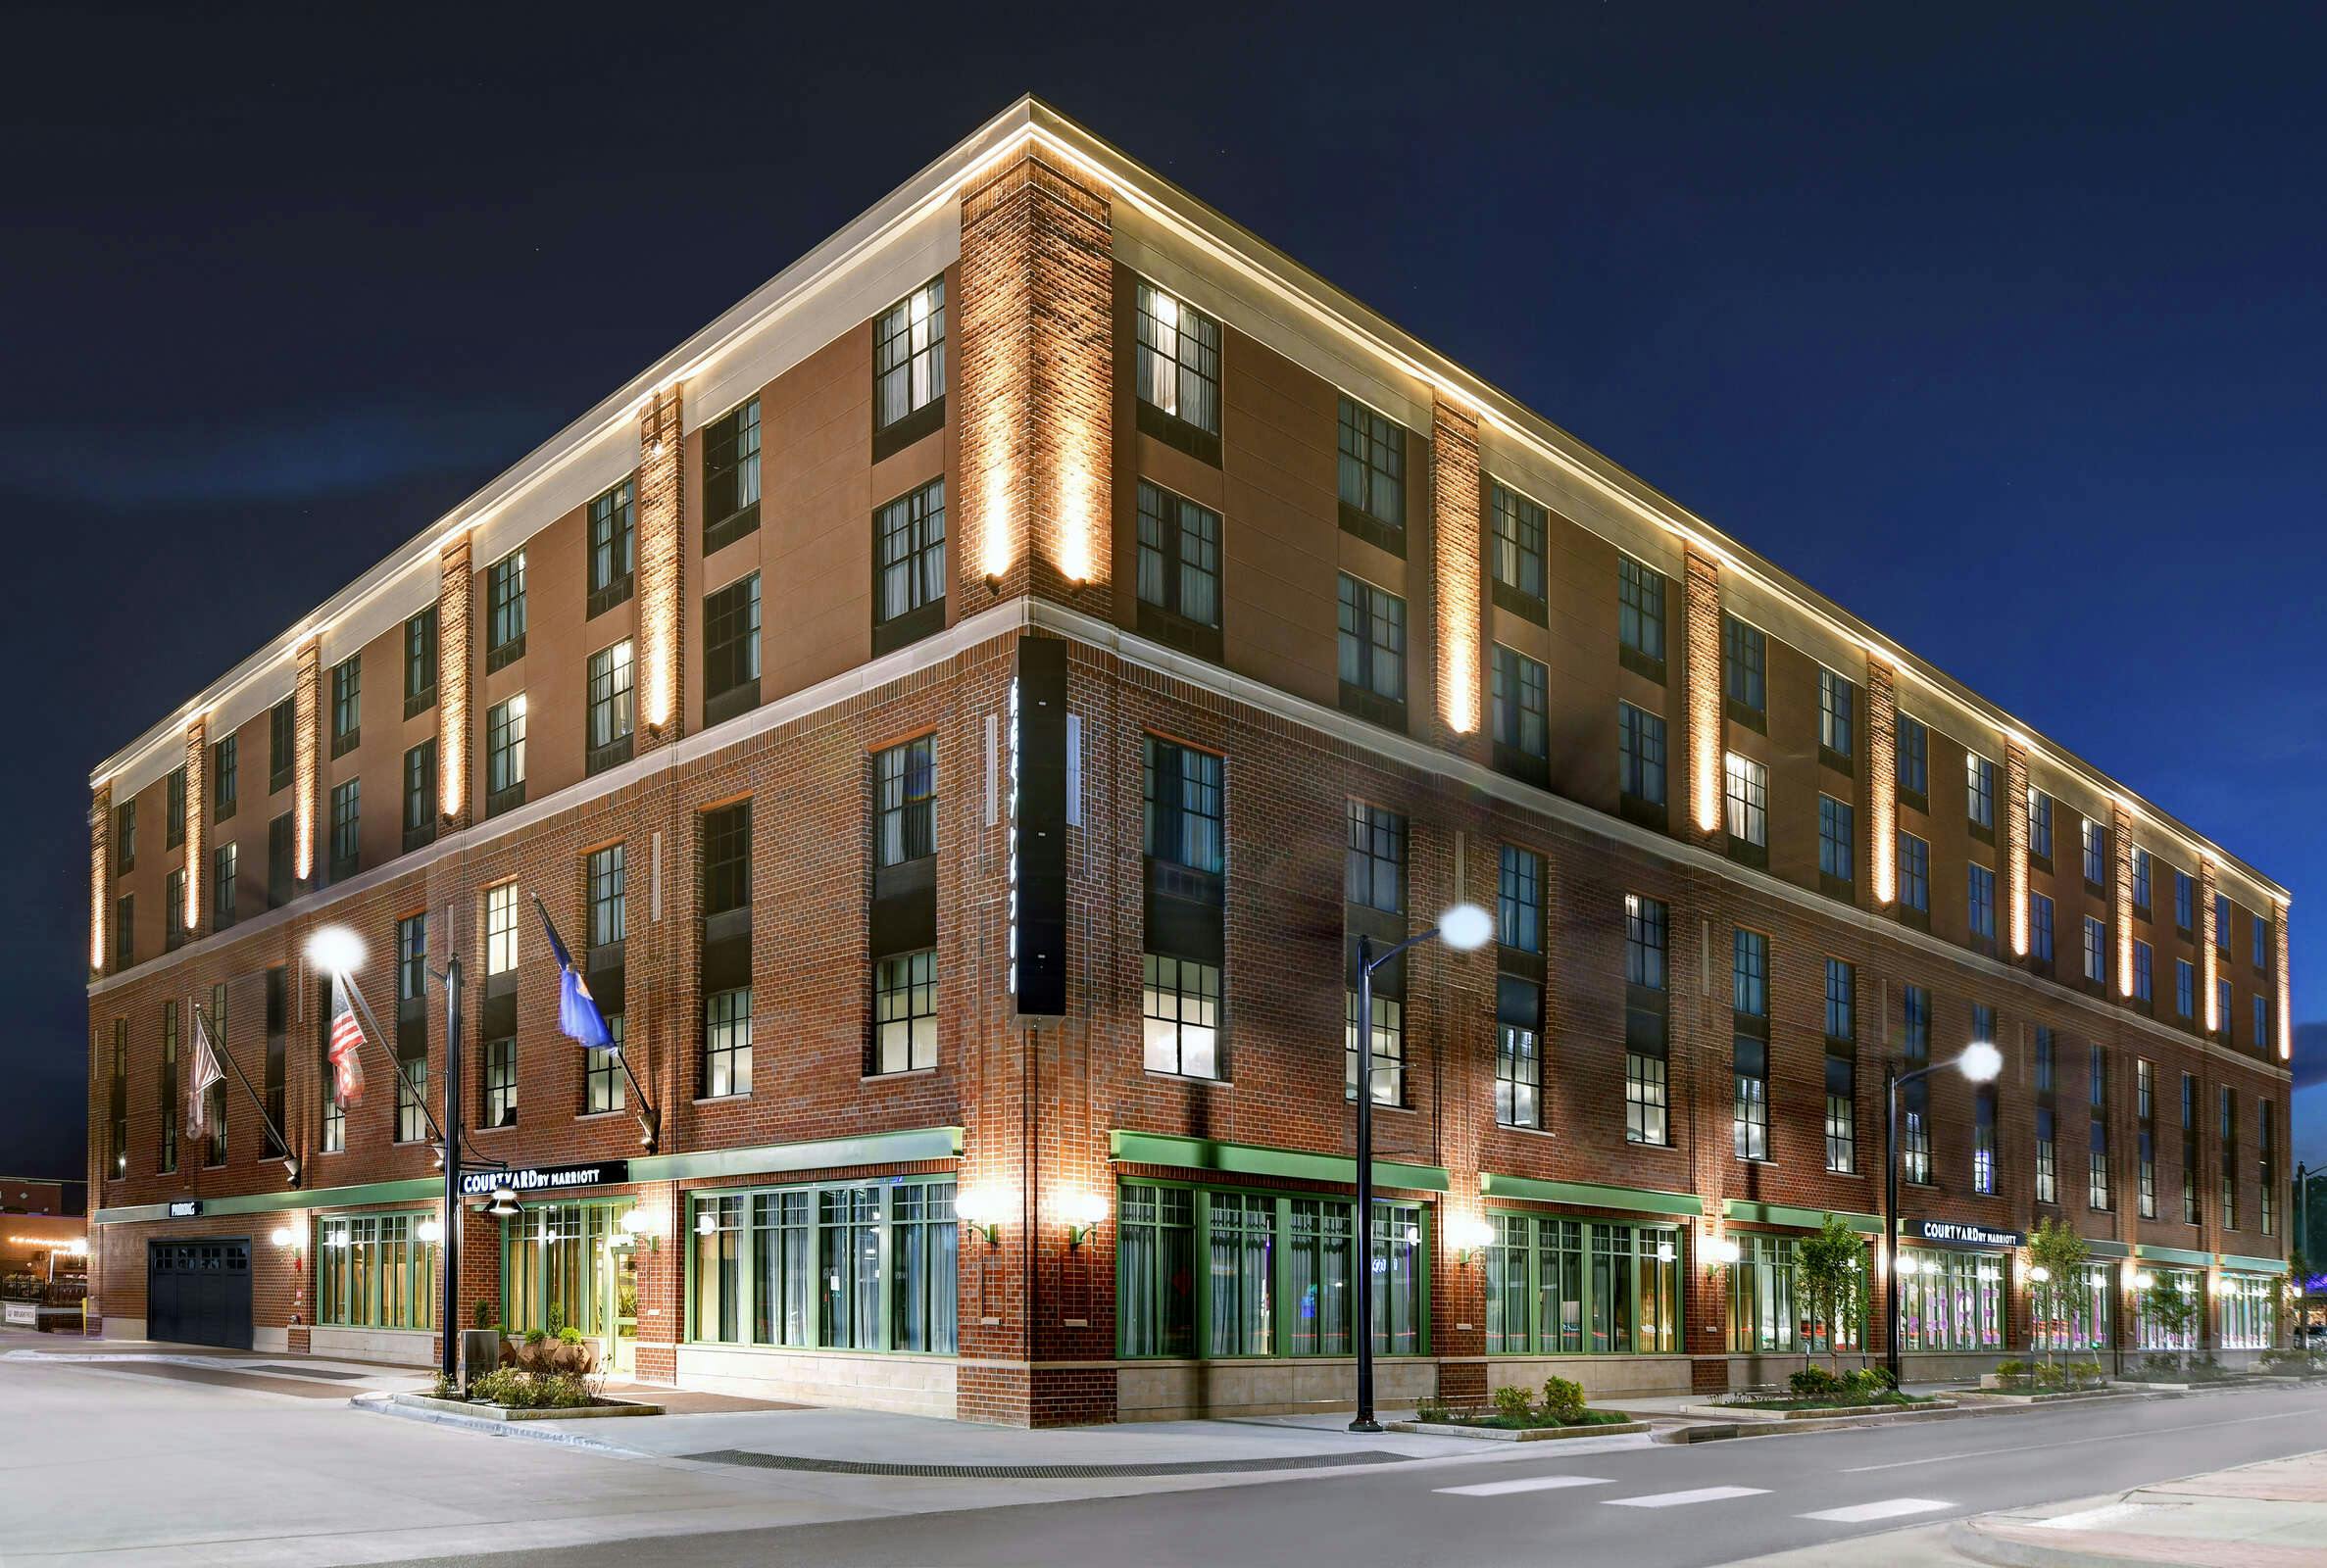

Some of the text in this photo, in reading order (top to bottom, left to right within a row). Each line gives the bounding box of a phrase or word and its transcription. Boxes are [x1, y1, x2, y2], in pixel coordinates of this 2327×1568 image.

[465, 1169, 600, 1193] COURTYARD BY MARRIOTT
[1924, 1222, 2016, 1245] COURTYARD BY MARRIOTT
